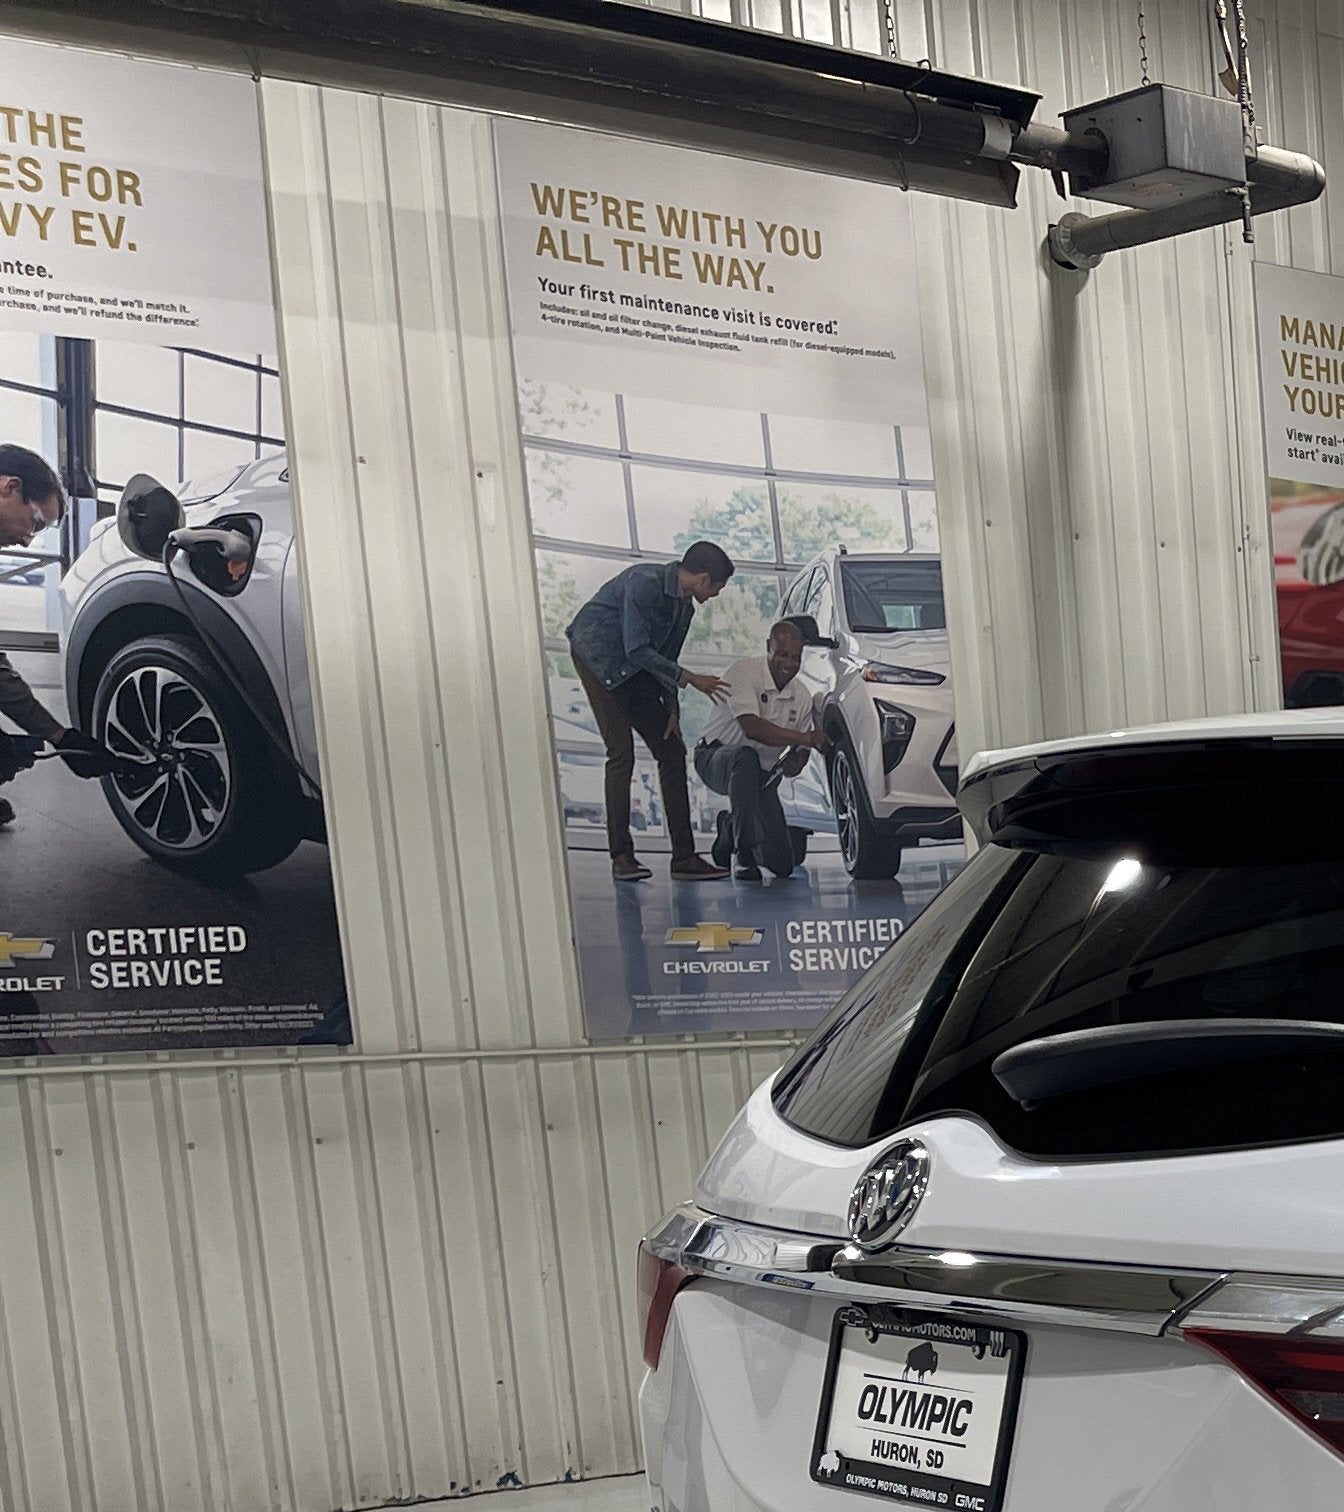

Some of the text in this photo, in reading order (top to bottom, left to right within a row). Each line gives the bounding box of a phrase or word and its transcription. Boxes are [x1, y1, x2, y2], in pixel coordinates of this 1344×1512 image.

[0, 105, 85, 152] THE
[59, 162, 143, 207] FOR
[72, 210, 137, 251] EV.
[530, 182, 823, 260] WE'RE WITH YOU
[536, 226, 775, 294] ALL THE WAY.
[43, 304, 61, 313] and
[90, 309, 123, 320] refund
[126, 313, 142, 322] the
[100, 297, 117, 306] and
[537, 276, 575, 297] Your
[579, 283, 616, 304] first
[620, 293, 719, 320] maintenance
[722, 307, 755, 325] visit
[759, 311, 771, 327] is
[1285, 427, 1313, 444] View
[87, 926, 247, 956] CERTIFIED
[786, 918, 904, 943] CERTIFIED
[89, 959, 223, 989] SERVICE
[663, 960, 771, 975] CHEVROLET
[857, 1384, 974, 1437] OLYMPIC
[870, 1439, 944, 1469] HURON, SD
[845, 1473, 948, 1504] OLYMPIC MOTORS, HURON SD
[955, 1494, 985, 1512] GMC
